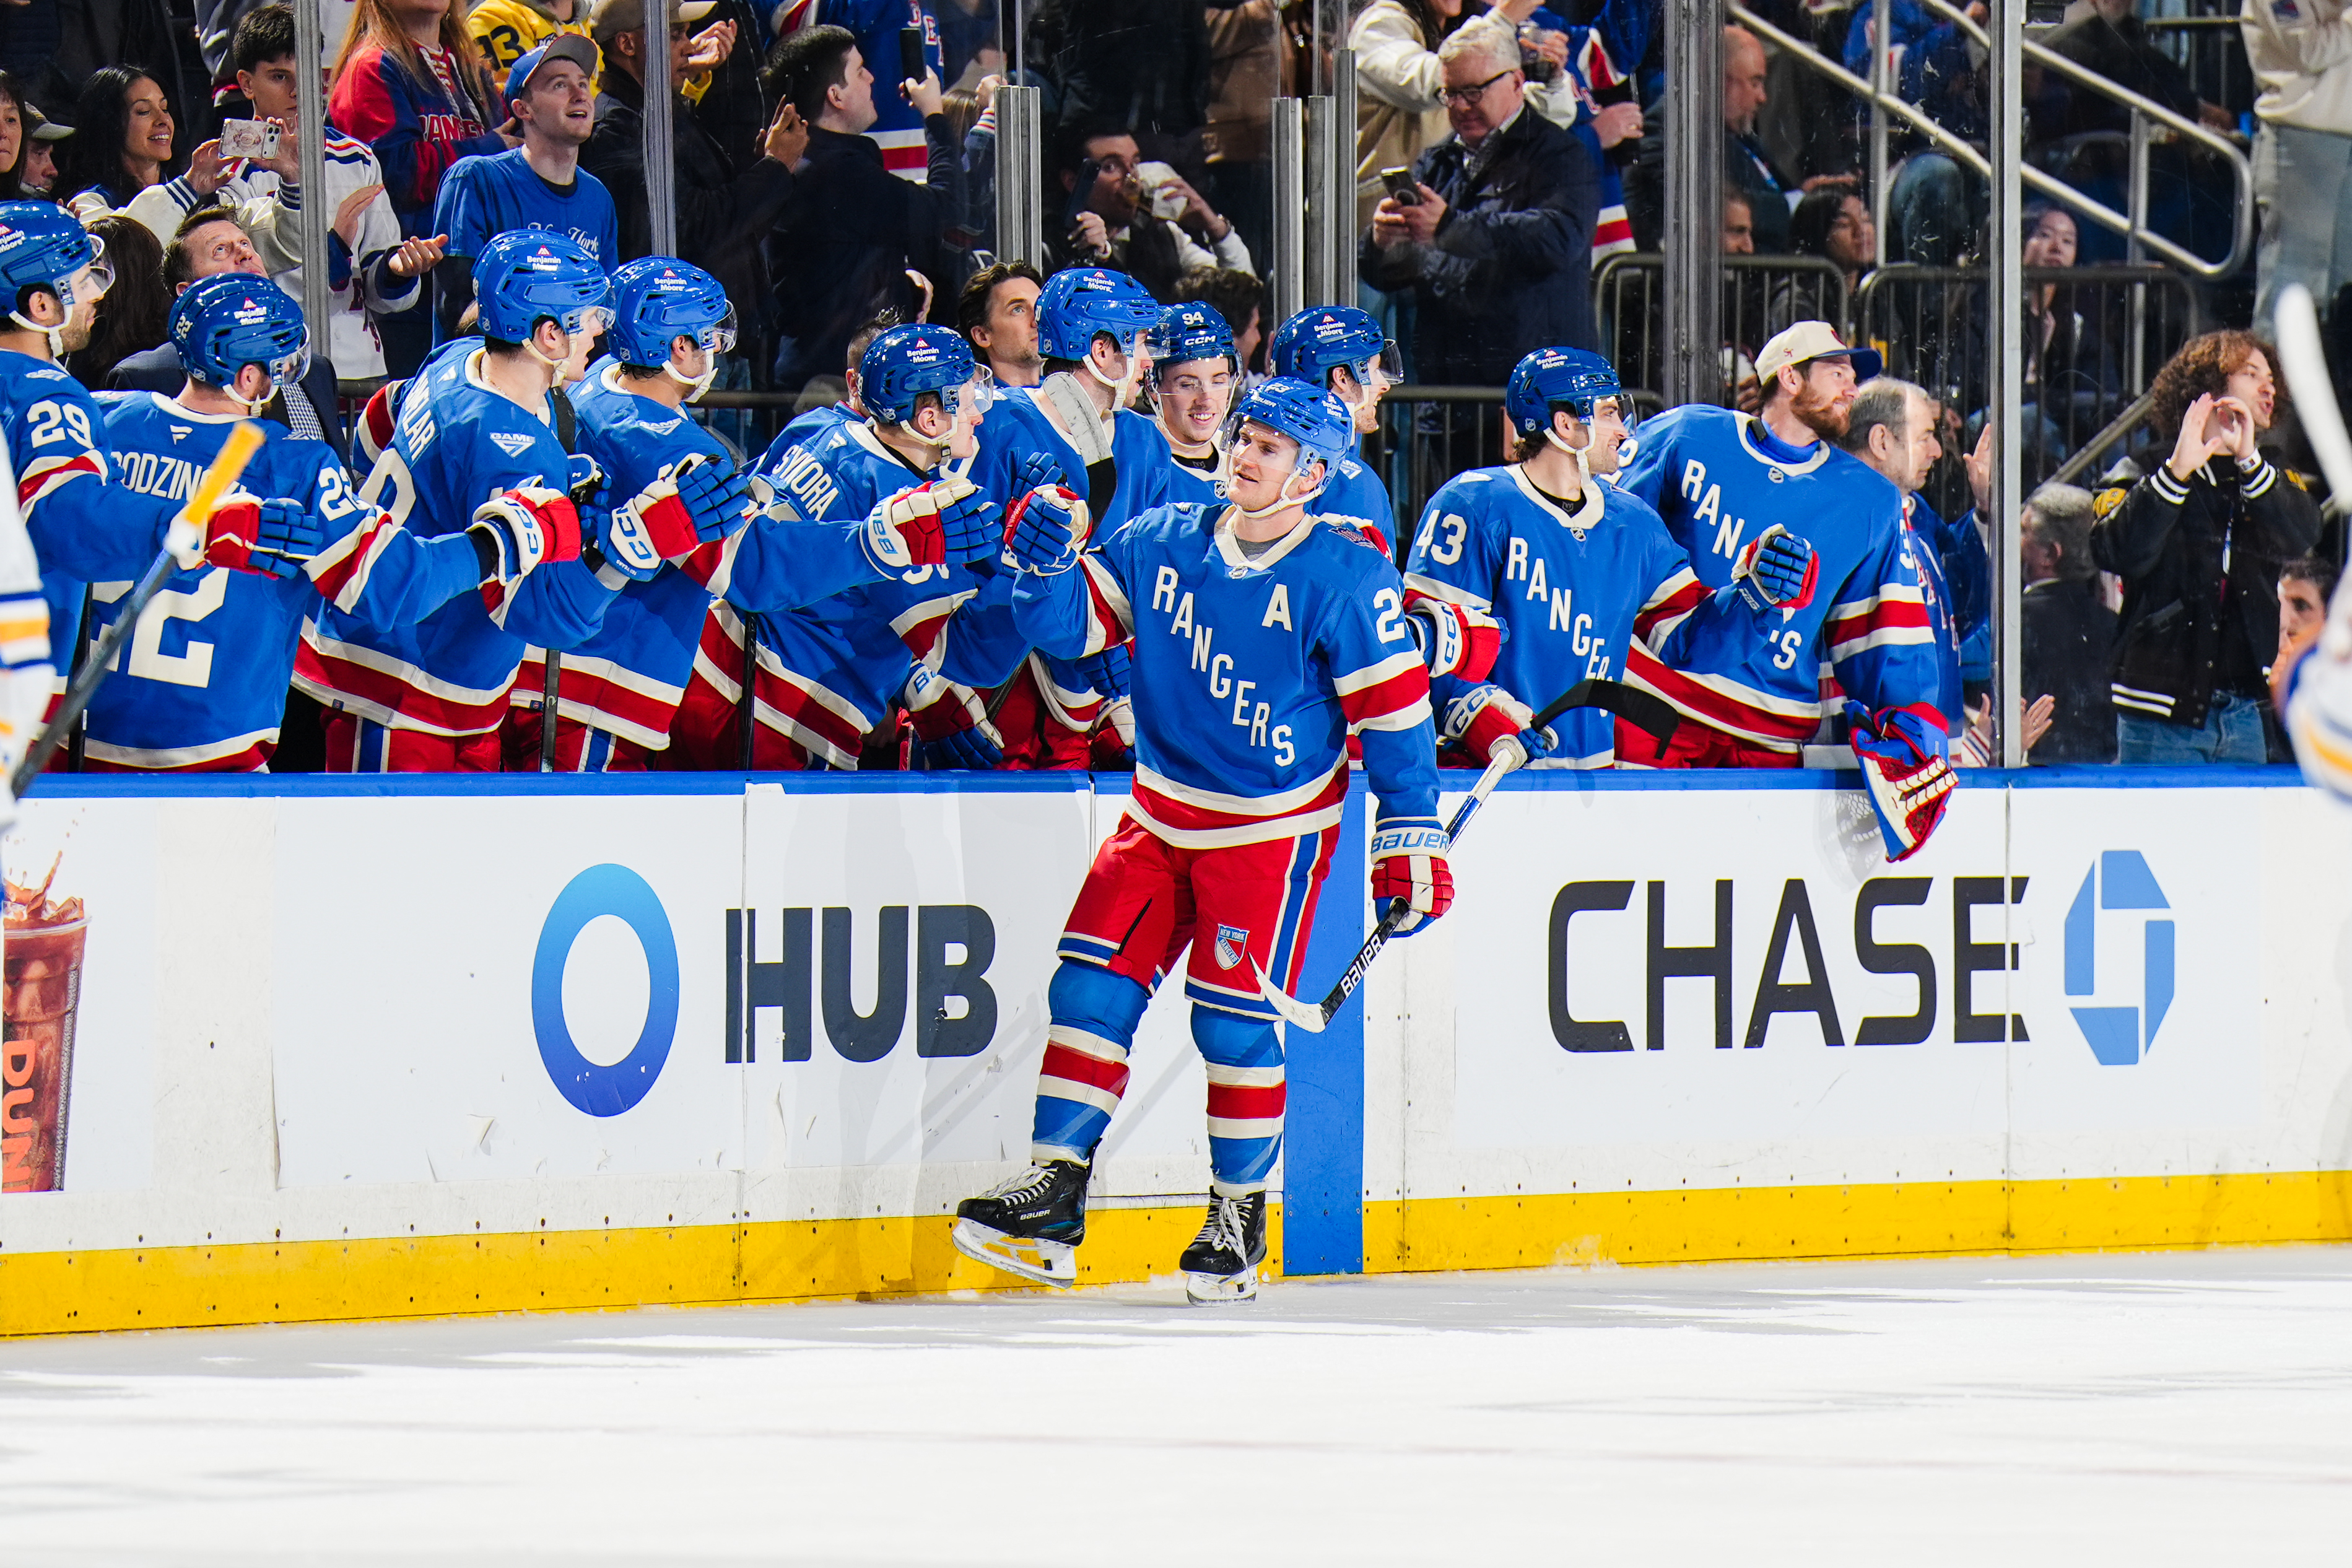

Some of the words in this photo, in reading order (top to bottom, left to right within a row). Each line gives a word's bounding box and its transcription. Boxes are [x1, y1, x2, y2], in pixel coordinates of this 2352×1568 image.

[474, 24, 526, 72] 13
[528, 256, 562, 264] Benjamin
[1083, 276, 1115, 287] Benjamin
[1087, 282, 1113, 293] Moore
[1182, 311, 1204, 325] 94
[1314, 321, 1346, 332] Benjamin
[1184, 335, 1216, 346] CCM
[1320, 328, 1344, 338] Moore
[906, 348, 939, 357] Benjamin
[1536, 354, 1568, 365] Benjamin
[1541, 360, 1565, 370] Moore
[1250, 394, 1277, 407] AUER
[27, 399, 95, 449] 29
[490, 433, 536, 442] GAME
[110, 451, 248, 500] ODZIN
[772, 444, 839, 521] SYKORA
[1416, 509, 1467, 565] 43
[1261, 583, 1293, 632] A
[1373, 587, 1406, 644] 2
[1507, 537, 1614, 717] RANGER
[1152, 565, 1296, 767] RANGERS
[1452, 685, 1505, 722] CCM
[1220, 928, 1231, 938] NEW
[1232, 931, 1245, 941] YORK
[1219, 938, 1238, 963] RANGERS
[1548, 876, 2030, 1052] CHASE
[725, 905, 998, 1064] HUB
[2, 1040, 36, 1191] DUN
